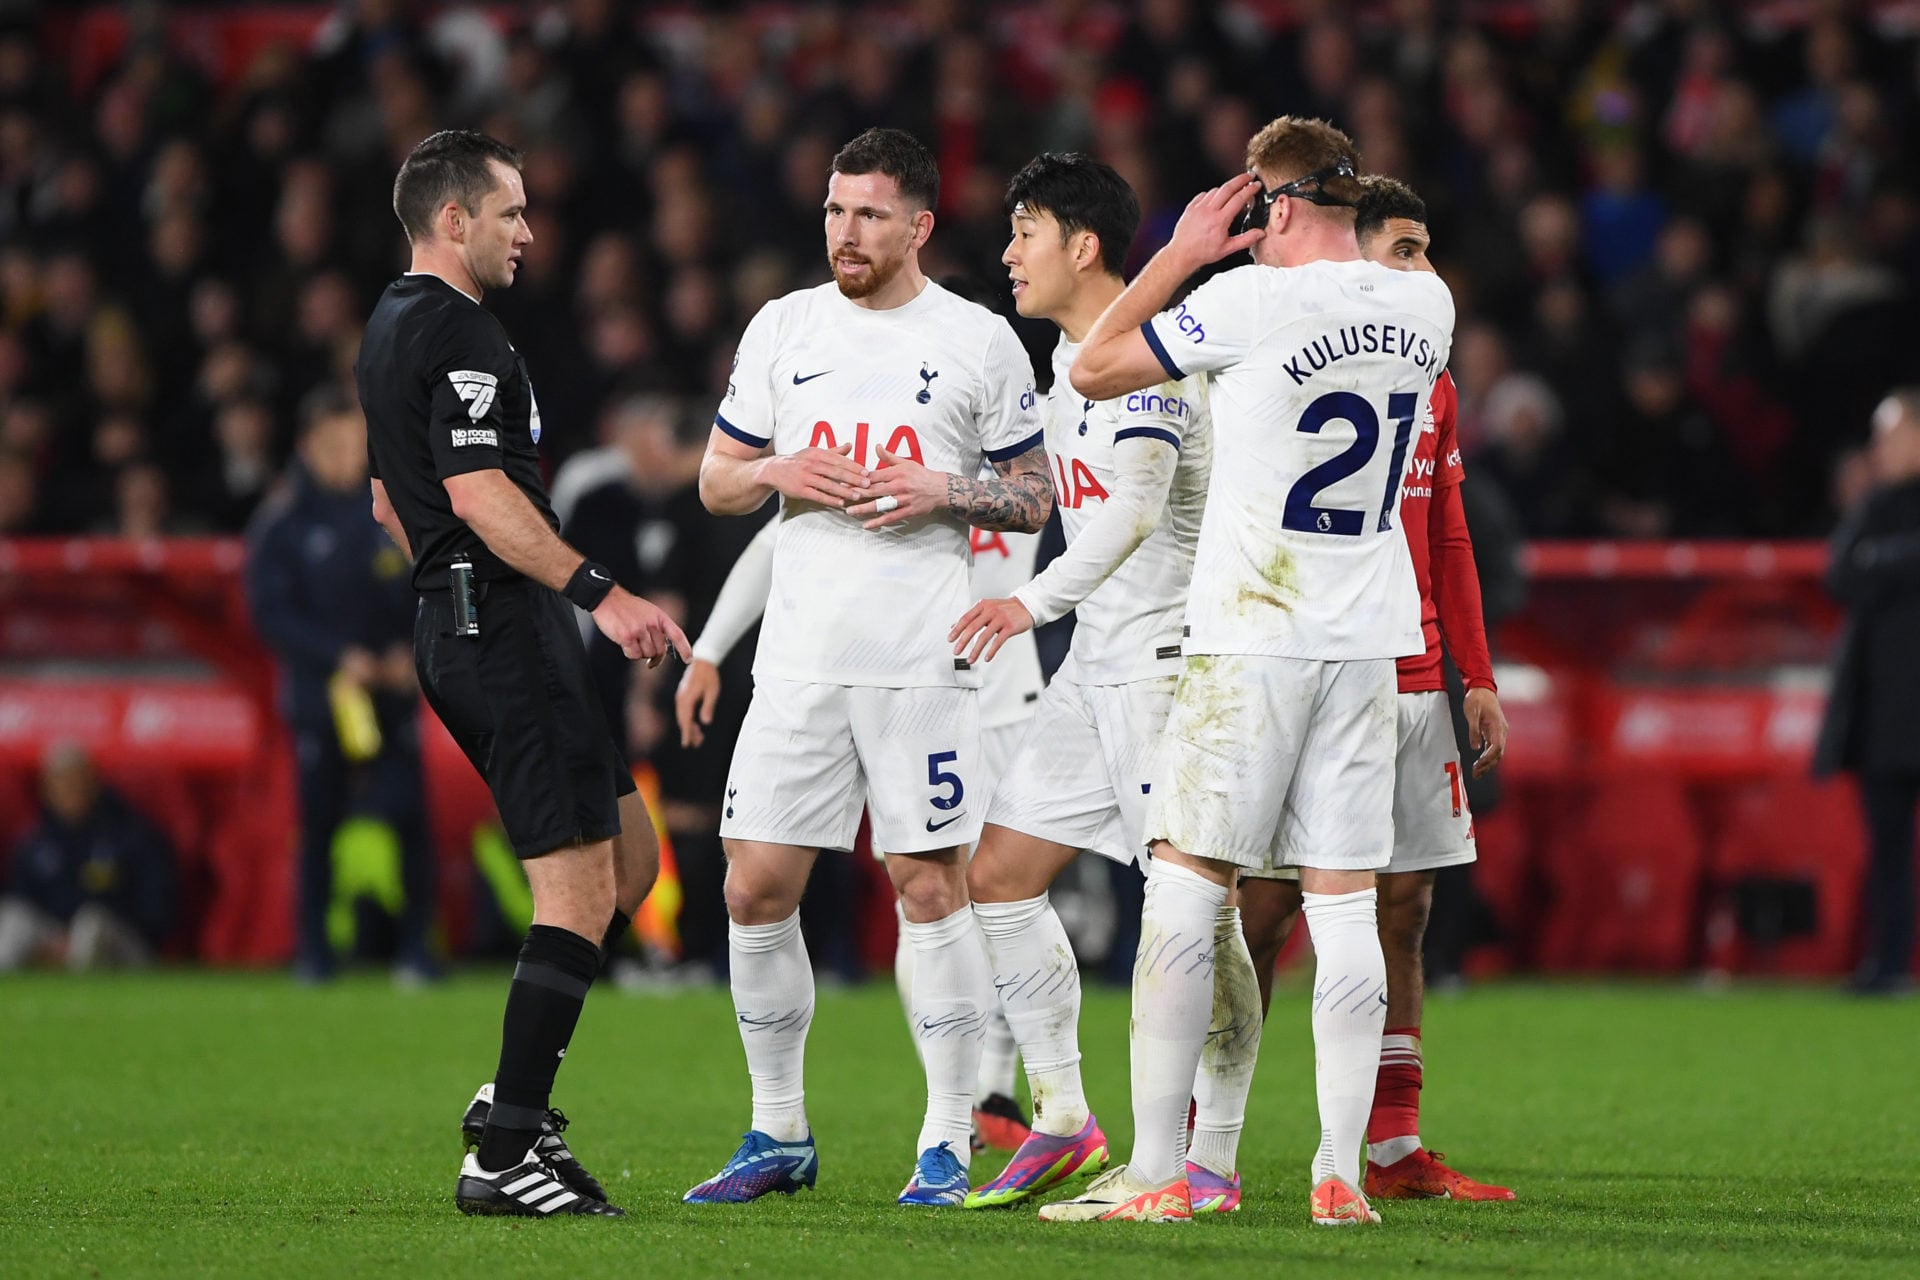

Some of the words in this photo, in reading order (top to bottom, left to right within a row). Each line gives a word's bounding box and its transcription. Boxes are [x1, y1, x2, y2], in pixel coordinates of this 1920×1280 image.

[1126, 389, 1190, 421] cinch
[451, 429, 467, 438] No
[468, 429, 494, 438] room
[453, 438, 467, 447] for
[1282, 391, 1418, 536] 21
[927, 750, 964, 811] 5
